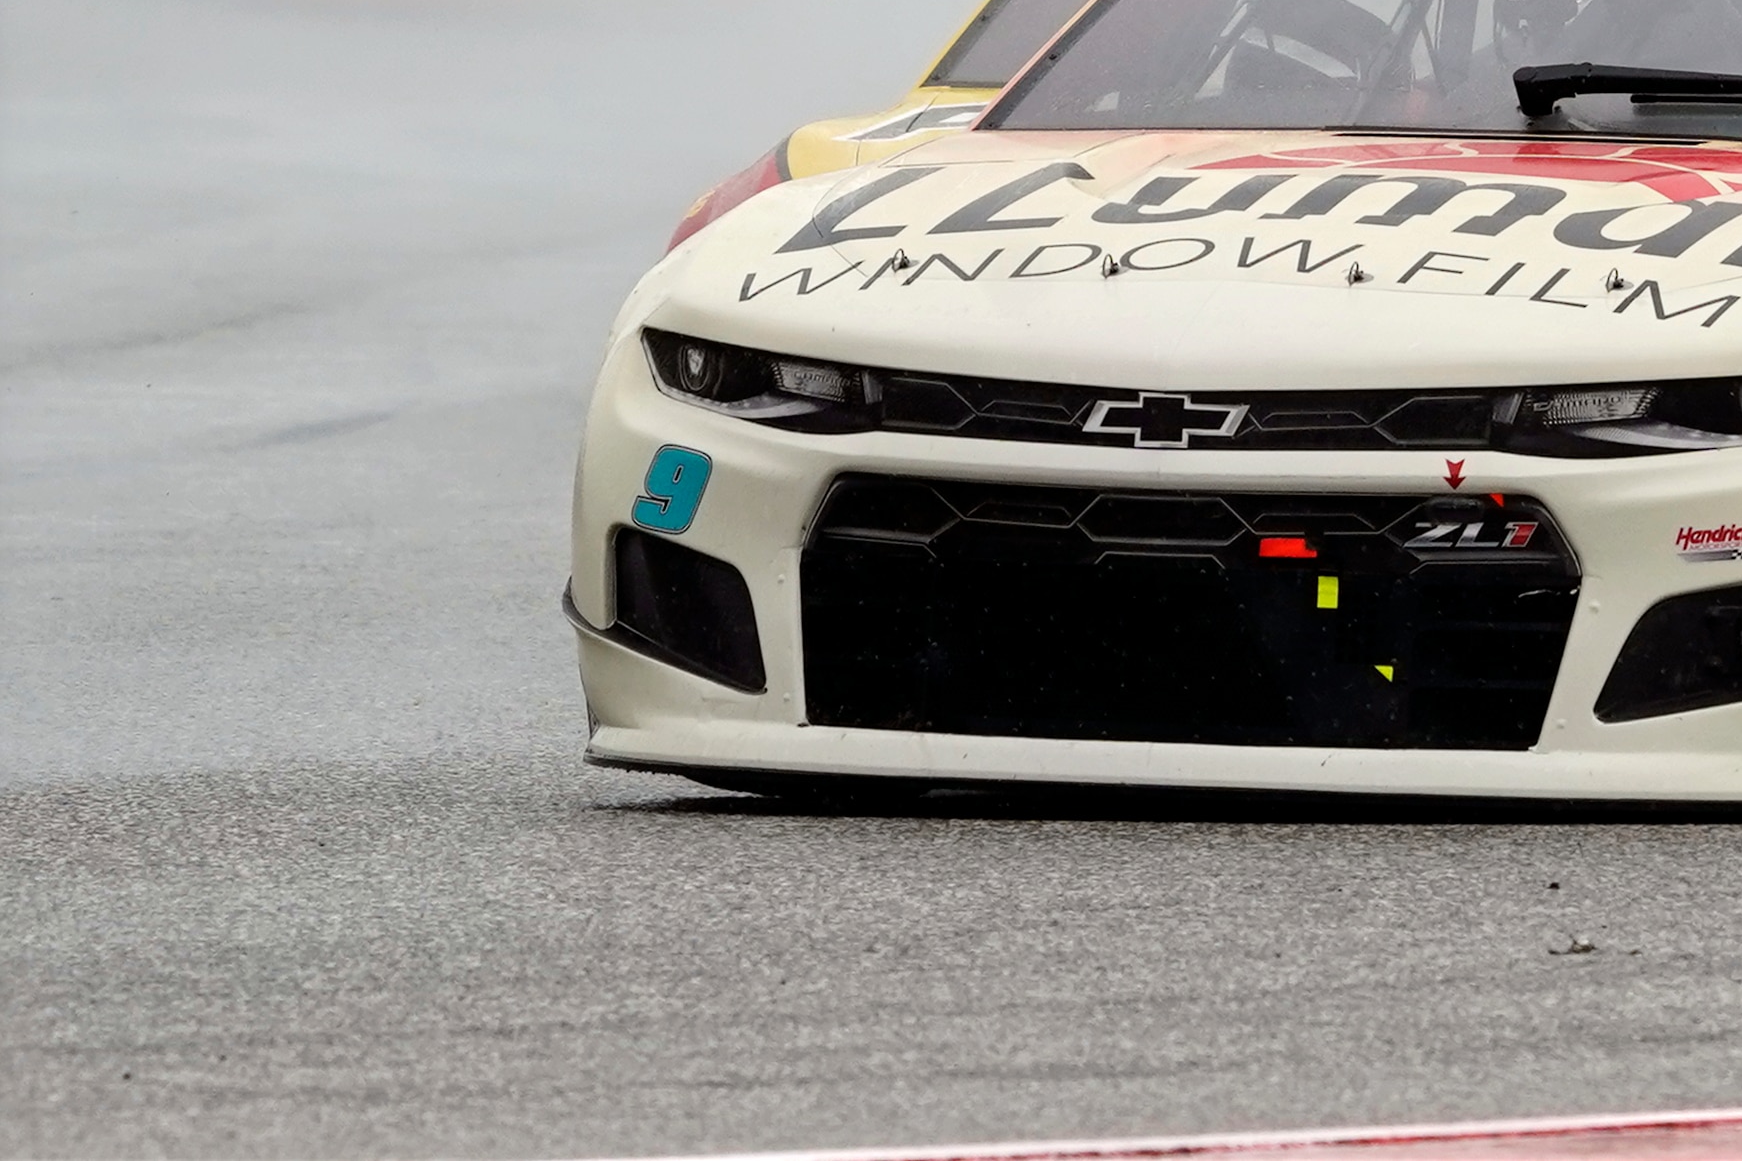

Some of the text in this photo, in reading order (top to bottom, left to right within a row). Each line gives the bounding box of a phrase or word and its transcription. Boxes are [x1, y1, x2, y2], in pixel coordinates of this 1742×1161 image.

[737, 236, 1741, 329] WINDOW FILM
[631, 443, 713, 535] 9
[1402, 521, 1539, 548] ZL1
